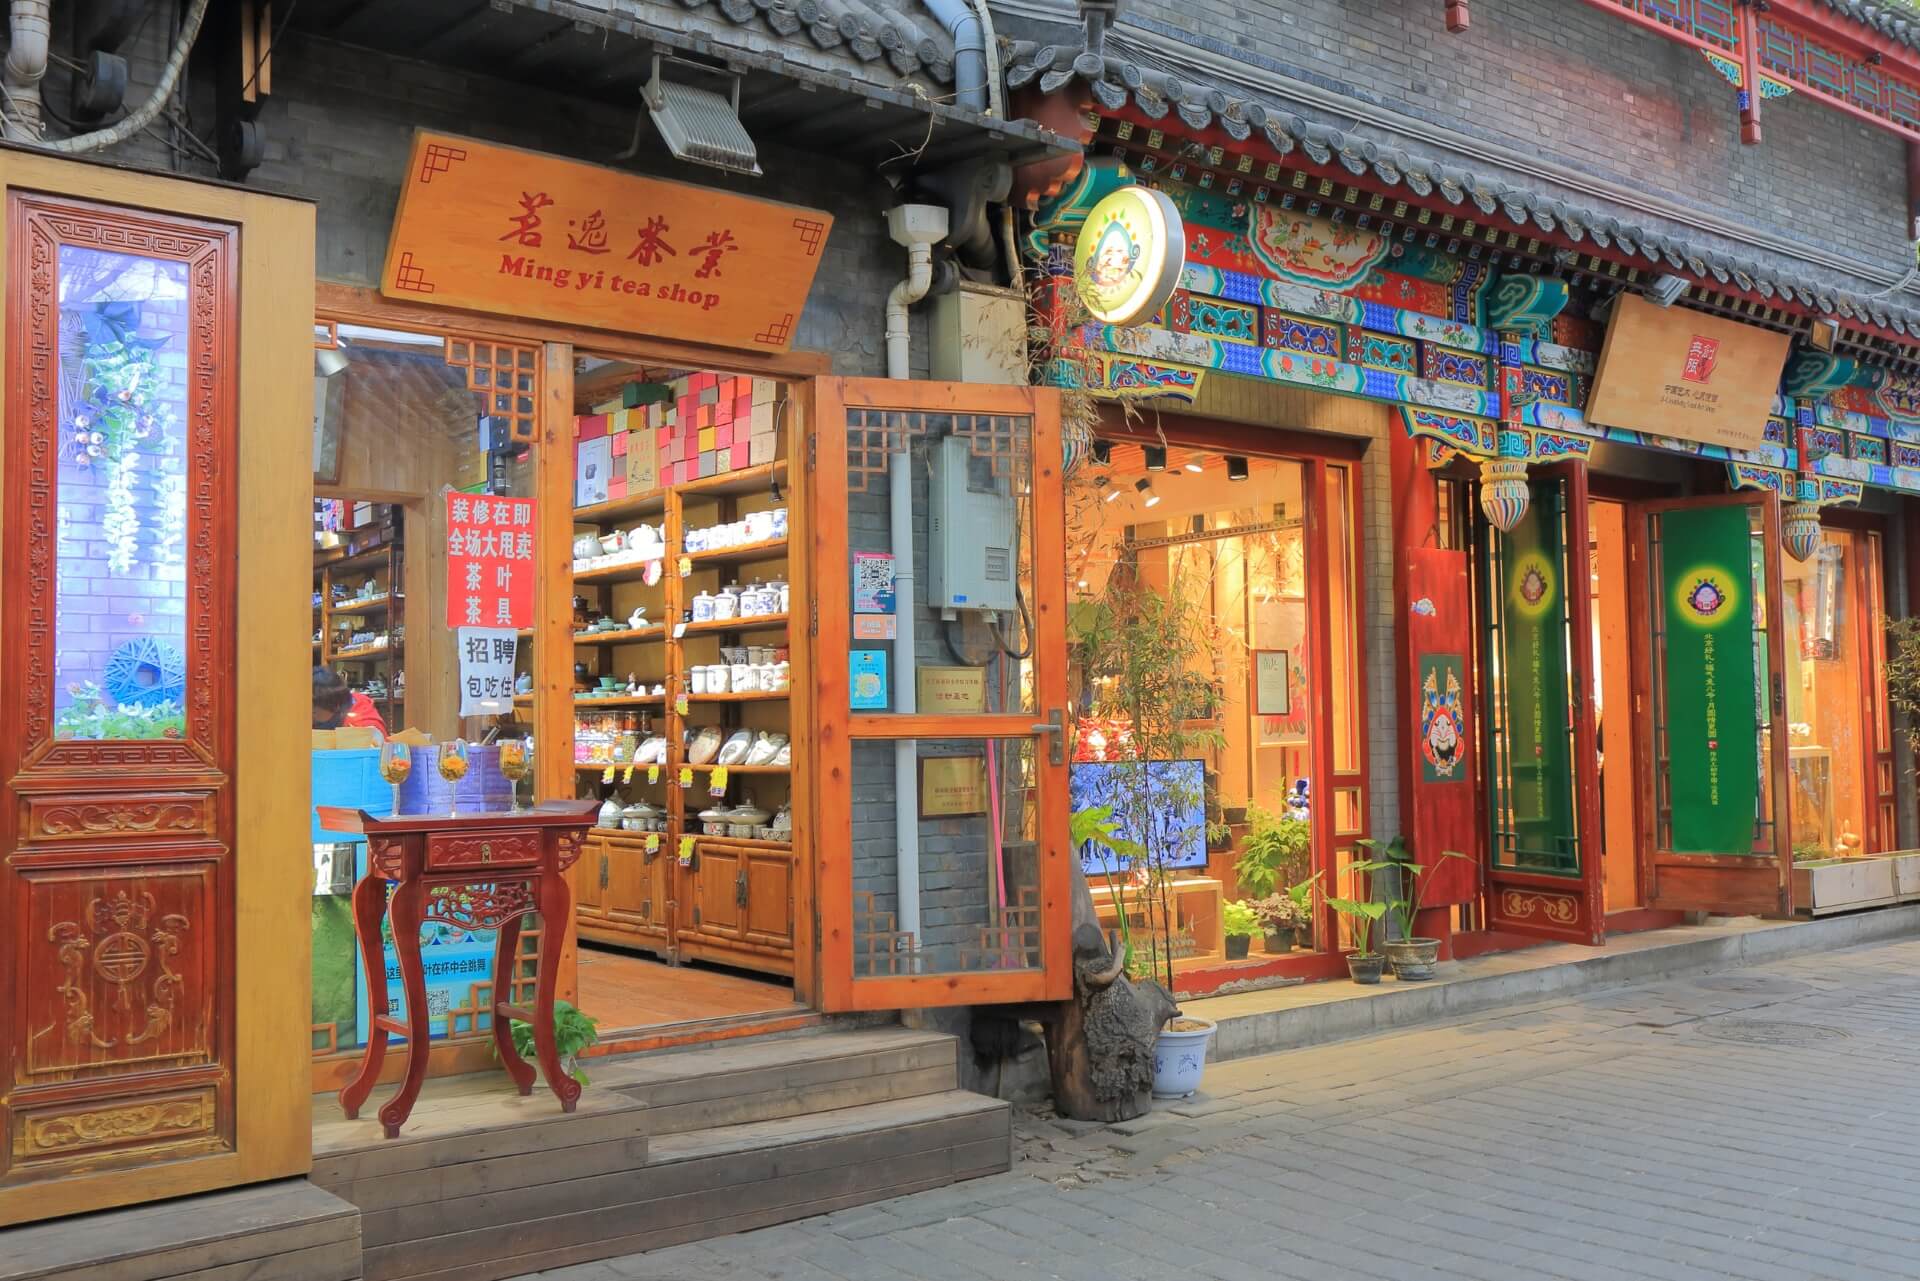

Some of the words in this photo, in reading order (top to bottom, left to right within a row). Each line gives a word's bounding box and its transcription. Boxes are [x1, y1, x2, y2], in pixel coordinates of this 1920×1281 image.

[498, 254, 572, 288] Ming
[575, 271, 604, 290] yi
[610, 274, 651, 297] tea
[656, 283, 721, 311] shop
[452, 498, 531, 528] 装修在即
[449, 528, 532, 561] 全场大甩卖
[466, 637, 515, 665] 招聘
[467, 675, 512, 699] 包吃住
